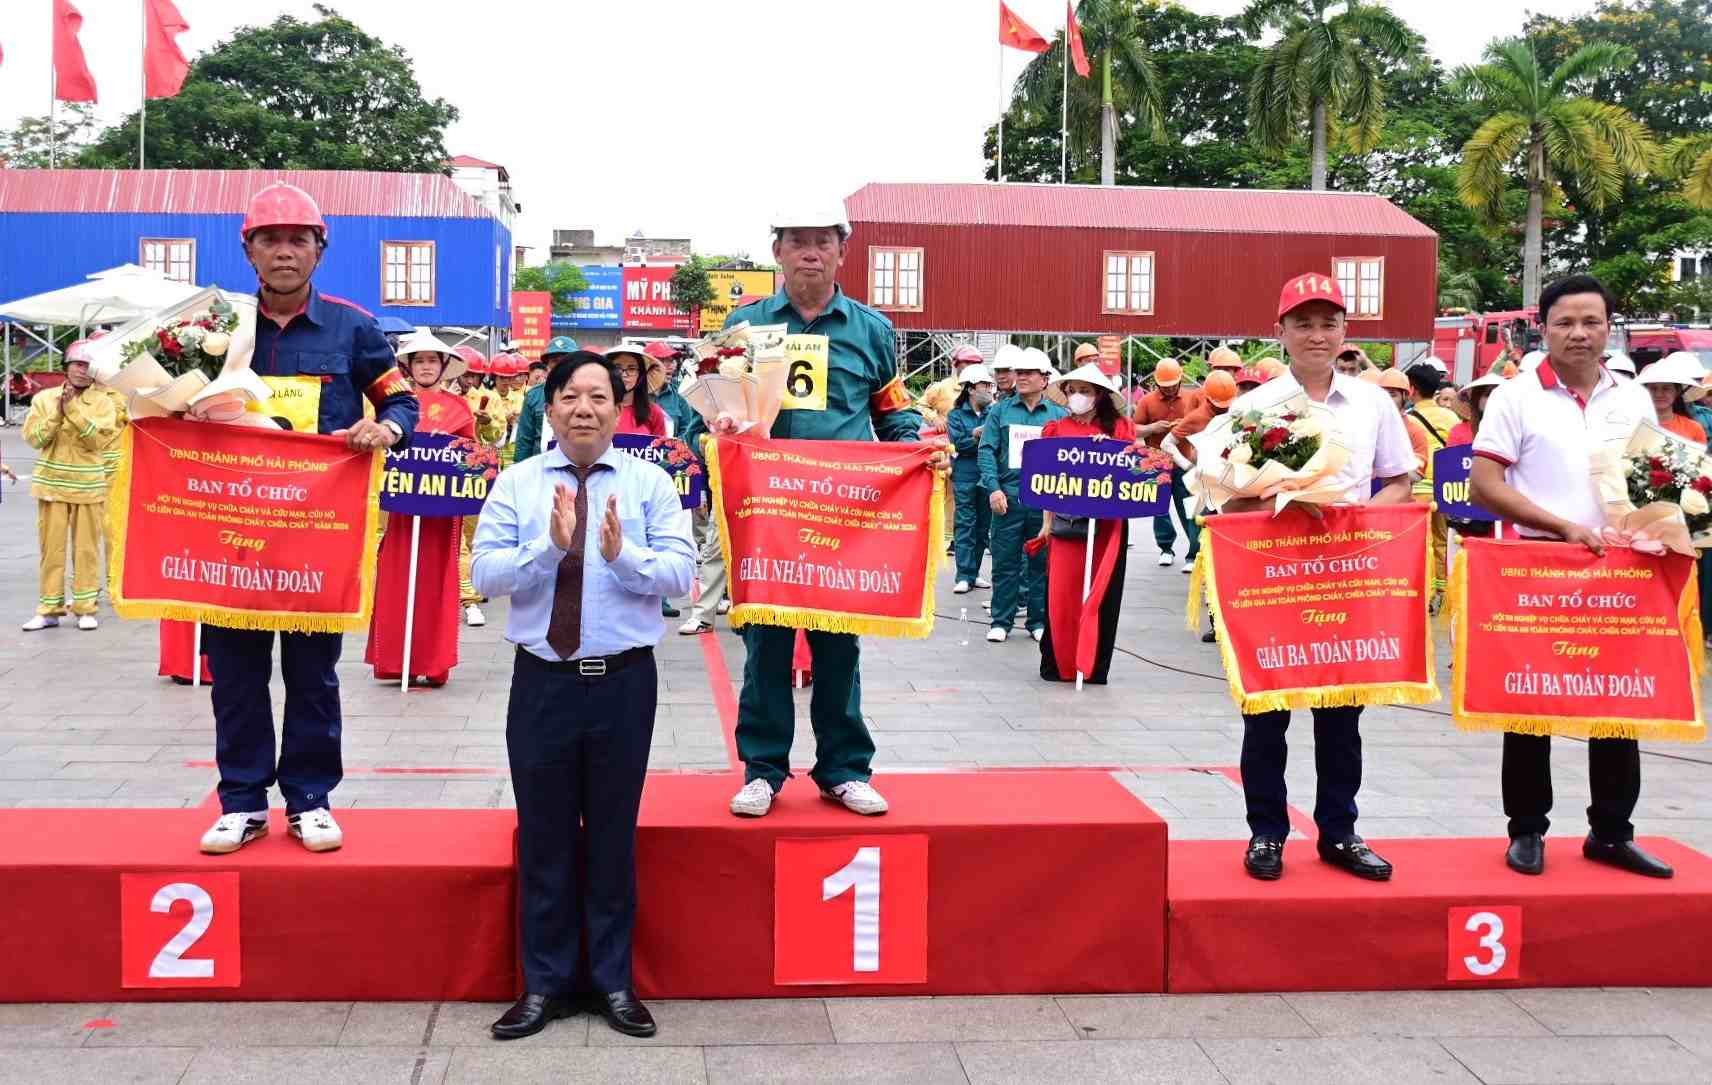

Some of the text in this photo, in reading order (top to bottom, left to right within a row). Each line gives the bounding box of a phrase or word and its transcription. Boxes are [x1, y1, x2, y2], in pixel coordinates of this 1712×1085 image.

[627, 277, 648, 301] MỸ
[1296, 276, 1333, 295] 114
[787, 360, 813, 398] 6
[170, 448, 199, 460] UBND
[412, 445, 462, 463] TUYỂN
[619, 445, 664, 461] UYỂN
[752, 451, 781, 461] UBND
[1057, 447, 1136, 468] ĐỘI TUYỂN
[187, 477, 308, 502] BAN TỔ CHỨC
[418, 474, 446, 496] AN
[451, 473, 487, 499] LÃO
[768, 475, 881, 502] BAN TỔ CHỨC
[1031, 473, 1083, 500] QUẬN
[1119, 480, 1157, 503] SƠN
[1442, 478, 1471, 505] QU
[218, 530, 267, 551] Tặng
[797, 528, 841, 550] Tặng
[1247, 539, 1273, 550] UBND
[162, 549, 324, 593] GIẢI NHÌ TOÀN ĐOÀN
[740, 547, 902, 594] GIẢI NHẤT TOÀN ĐOÀN
[1264, 554, 1378, 578] BAN TỔ CHỨC
[1501, 567, 1527, 577] UBND
[1518, 589, 1636, 609] BAN TỔ CHỨC
[1302, 609, 1348, 628] Tặng
[1257, 632, 1400, 669] GIẢI BA TOÀN ĐOÀN
[1551, 640, 1600, 659] Tặng
[1505, 663, 1656, 698] GIẢI BA TOÀN ĐOÀN
[822, 847, 881, 972] 1
[148, 883, 215, 978] 2
[1463, 911, 1506, 976] 3
